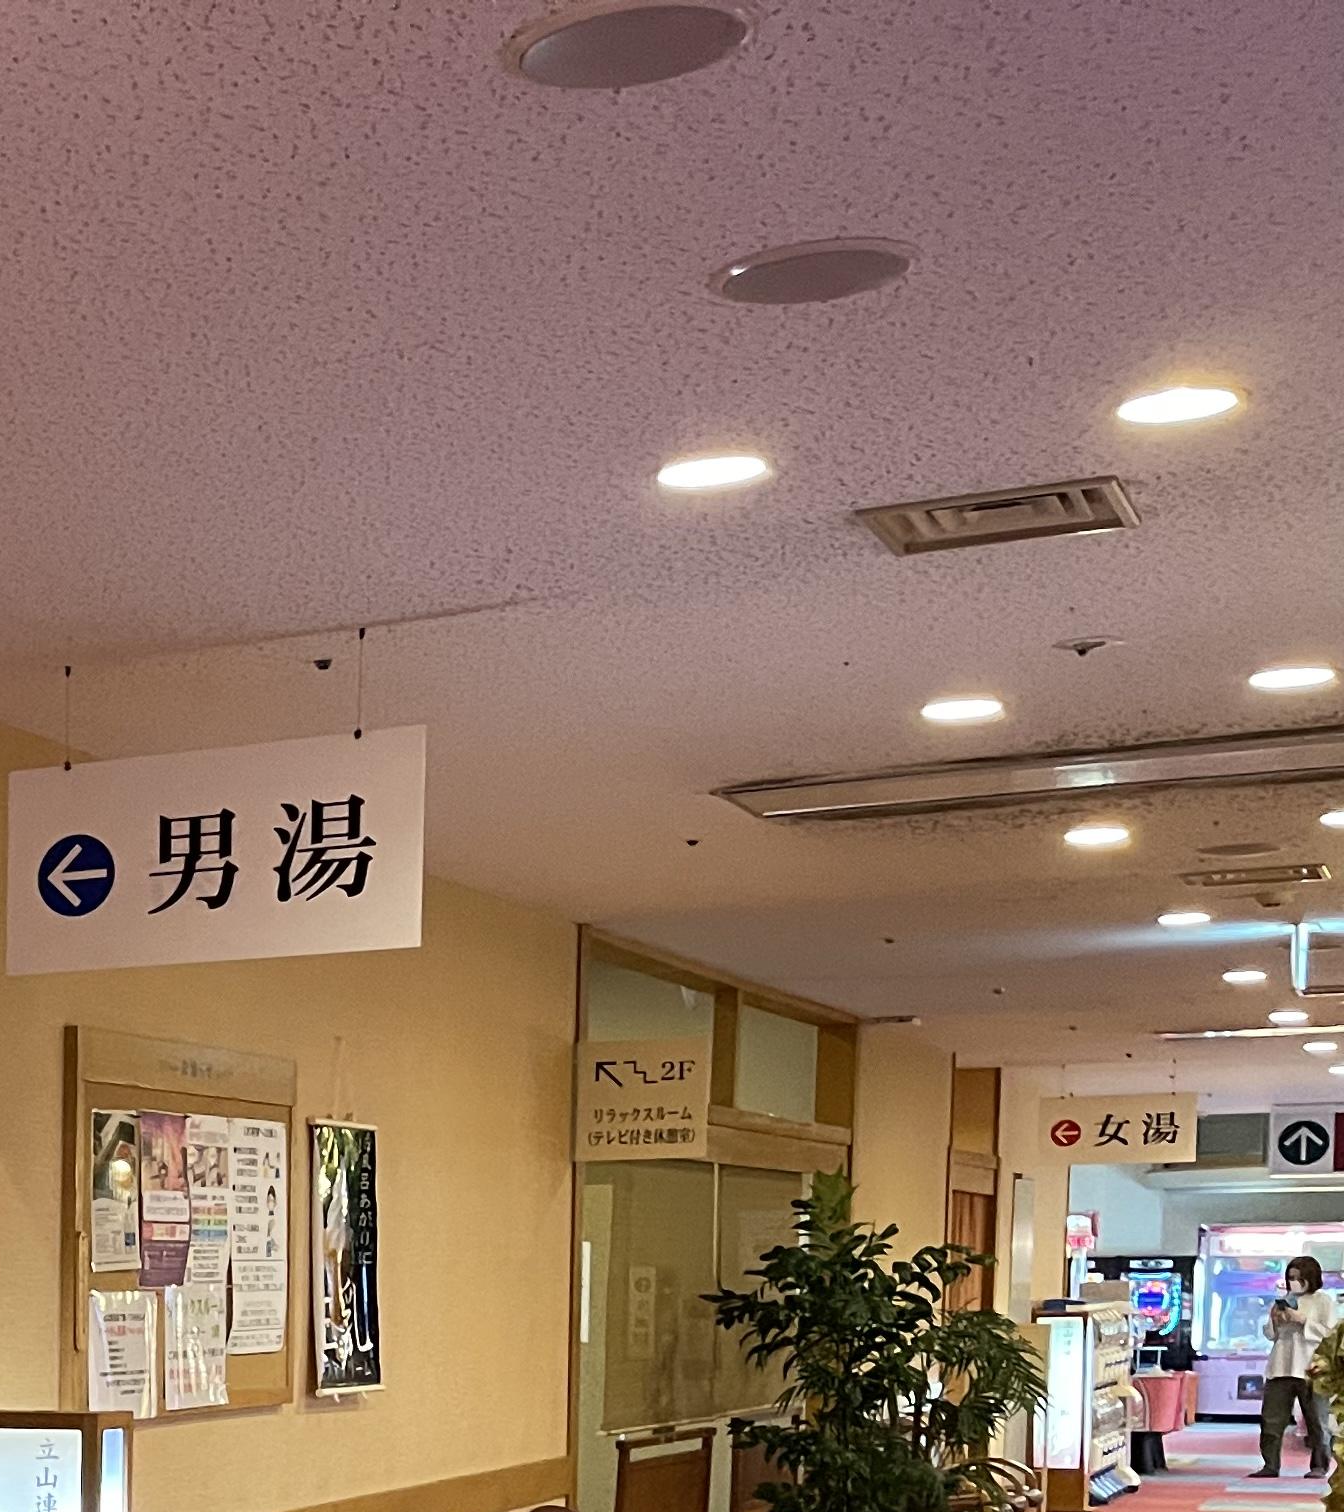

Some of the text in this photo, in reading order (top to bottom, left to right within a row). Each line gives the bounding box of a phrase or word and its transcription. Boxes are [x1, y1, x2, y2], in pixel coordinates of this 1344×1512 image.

[147, 794, 378, 915] 男湯
[661, 1060, 696, 1081] 2F
[593, 1105, 693, 1124] リラックスルーム
[1093, 1110, 1181, 1148] 女湯
